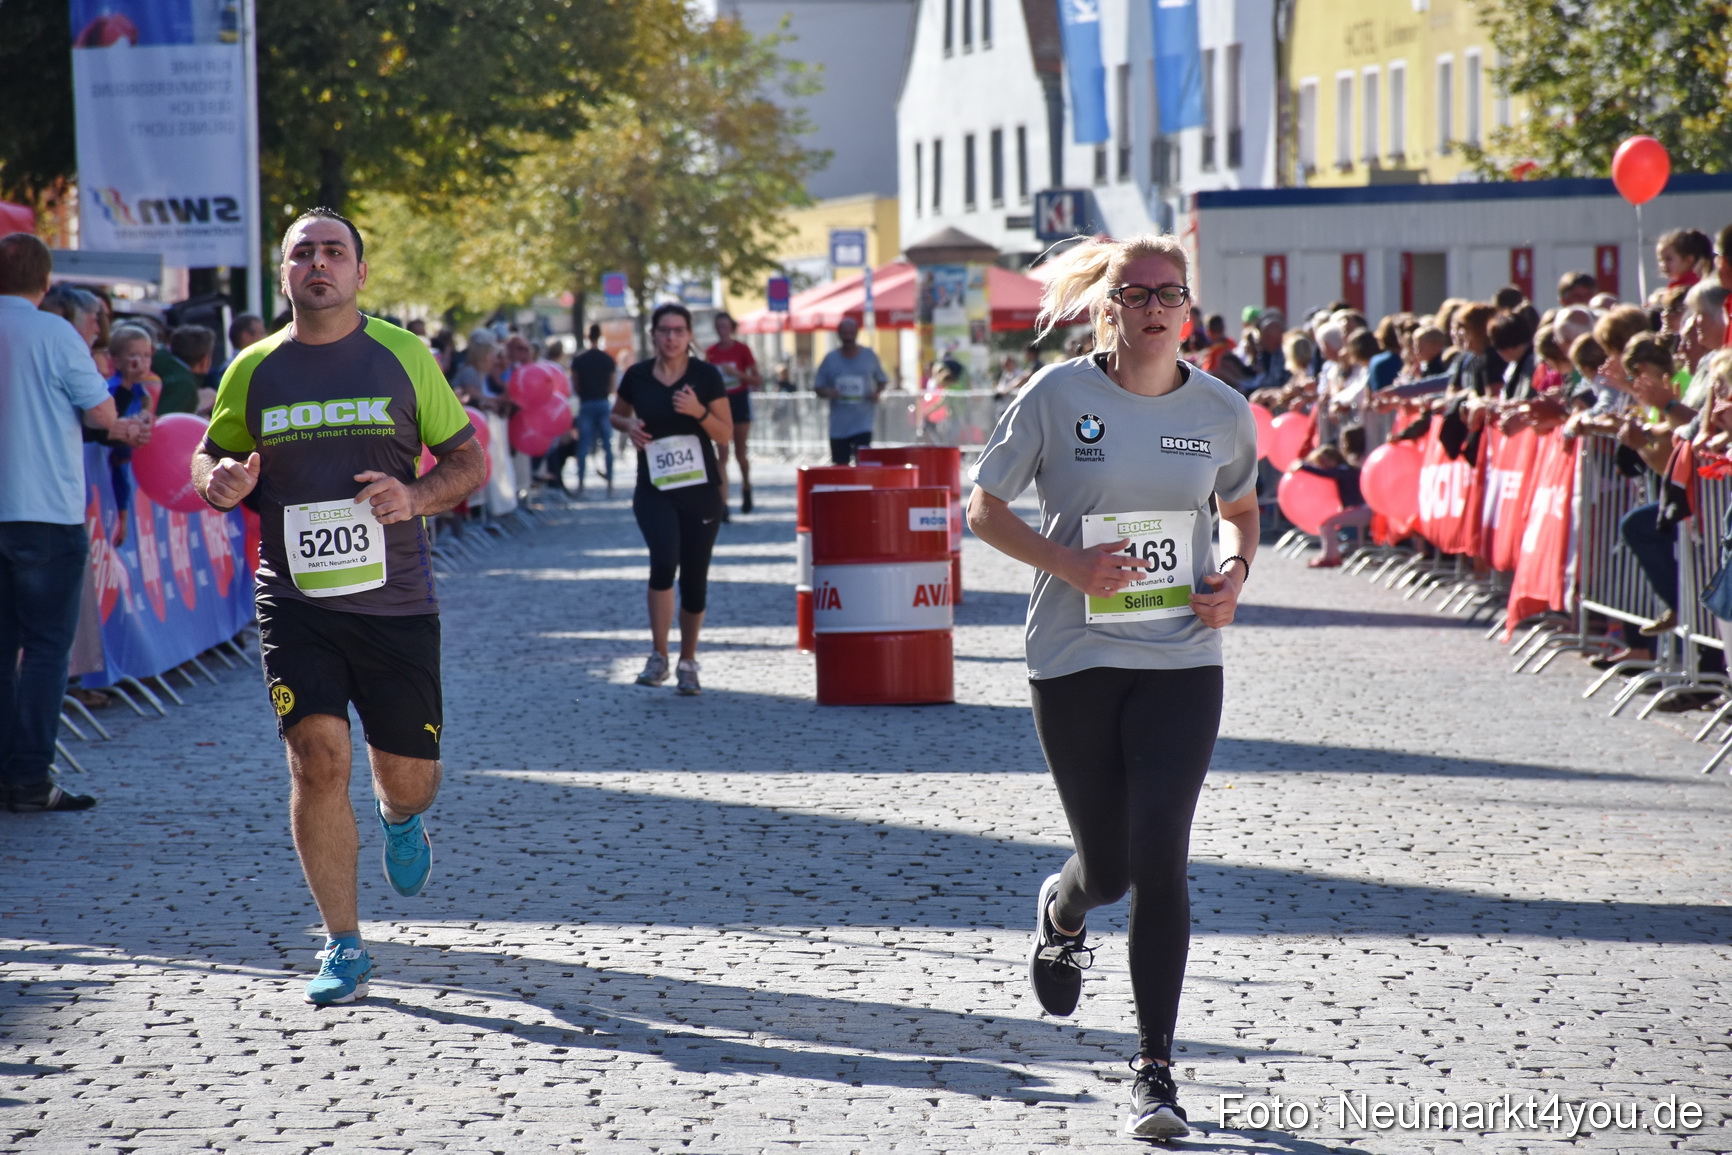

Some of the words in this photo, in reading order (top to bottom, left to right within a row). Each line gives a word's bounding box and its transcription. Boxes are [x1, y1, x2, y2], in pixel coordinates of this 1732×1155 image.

[262, 397, 396, 437] BOCK
[262, 432, 298, 447] inspired
[301, 431, 314, 440] by
[317, 428, 348, 438] smart
[351, 427, 396, 436] concepts
[1160, 436, 1211, 455] BOCK
[656, 448, 694, 469] 5034
[1075, 447, 1105, 456] PARTL
[309, 507, 353, 521] BOCK
[1117, 519, 1162, 534] BOCK
[300, 523, 370, 559] 5203
[308, 561, 328, 569] PARTL
[329, 558, 358, 567] Neumarkt
[1112, 538, 1178, 573] 163
[1136, 577, 1165, 587] Neumarkt
[1124, 594, 1164, 609] Selina
